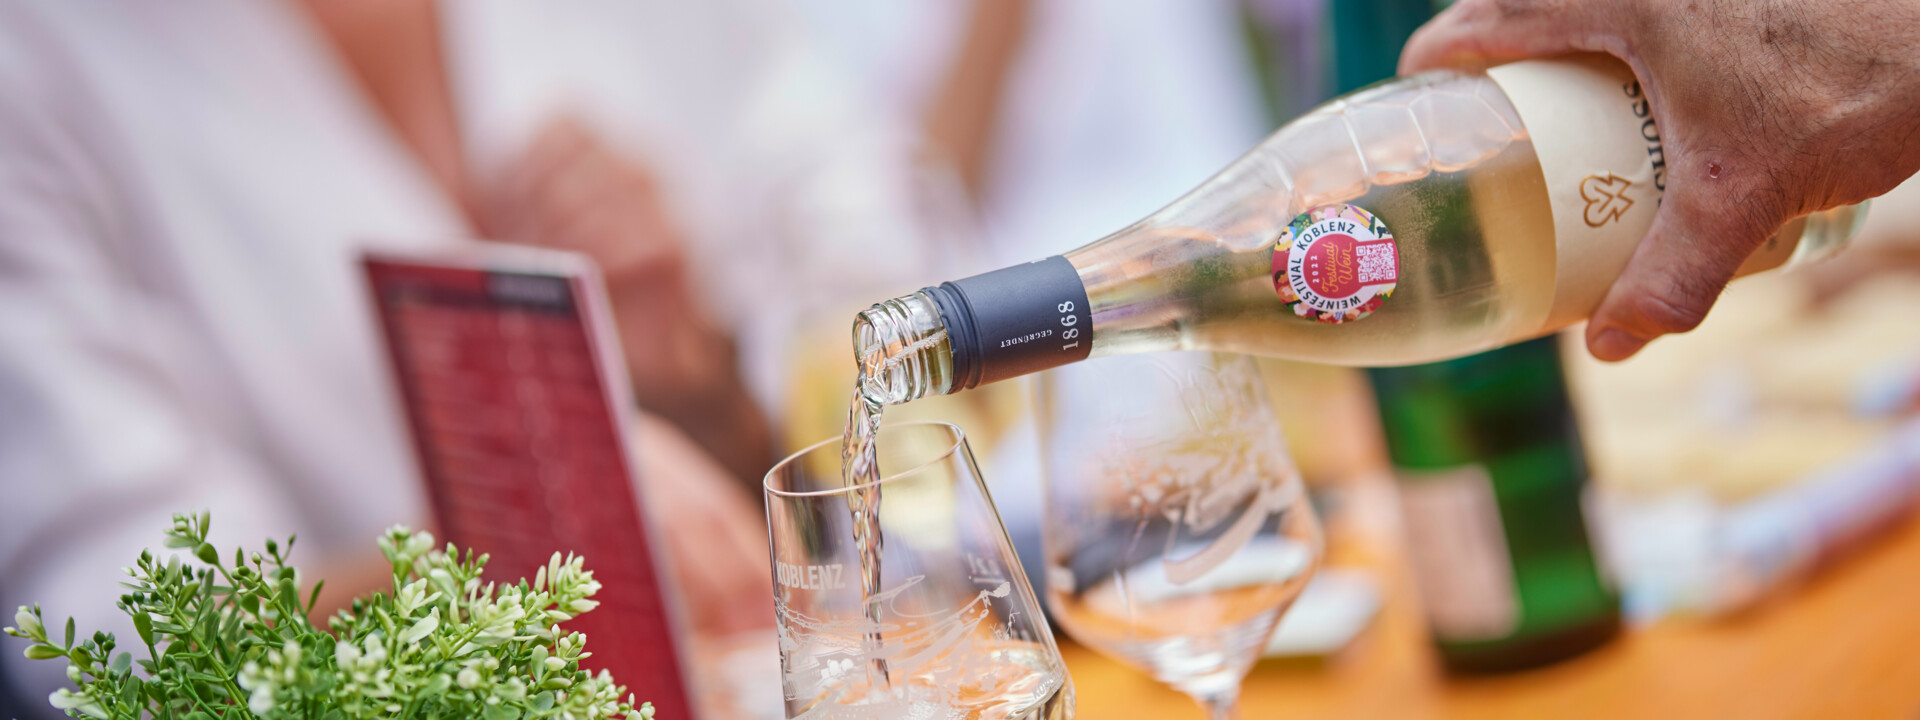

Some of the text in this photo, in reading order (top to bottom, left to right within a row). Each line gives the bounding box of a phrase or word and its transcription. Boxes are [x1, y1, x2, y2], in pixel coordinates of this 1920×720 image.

[1291, 221, 1361, 310] WEINFESTIVAL KOBLENZ
[1310, 255, 1320, 284] 2022
[1321, 241, 1339, 293] Festival
[1338, 242, 1353, 285] Wein
[1000, 329, 1053, 348] GEGRÜNDET
[1057, 300, 1079, 351] 1868
[775, 560, 846, 590] KOBLENZ
